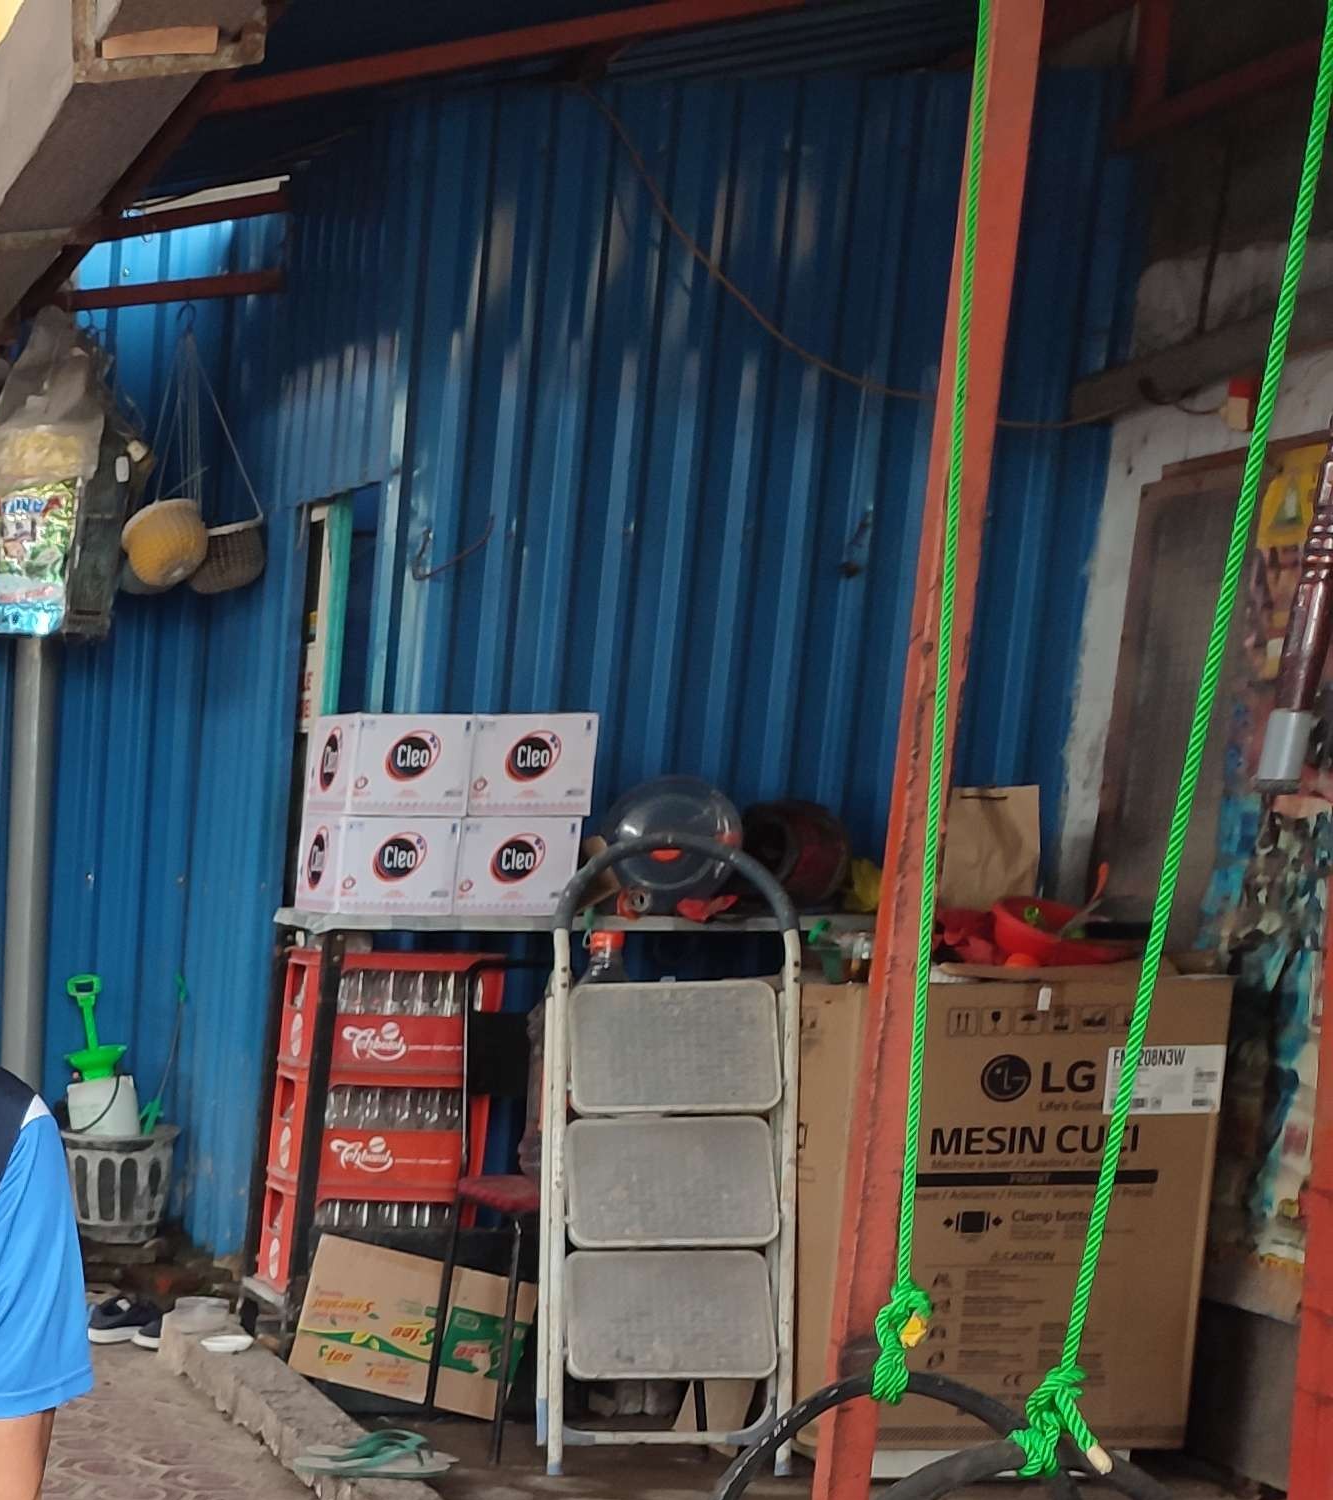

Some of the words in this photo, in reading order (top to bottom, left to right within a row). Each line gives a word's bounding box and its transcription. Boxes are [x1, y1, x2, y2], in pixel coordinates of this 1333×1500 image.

[396, 744, 430, 768] Cleo
[516, 744, 551, 769] Cleo
[383, 845, 417, 871] Cleo
[501, 846, 535, 871] Cleo
[1041, 1060, 1096, 1094] LG
[930, 1126, 1046, 1156] MESIN
[1056, 1124, 1140, 1154] CUI
[1011, 1209, 1053, 1225] Clamp
